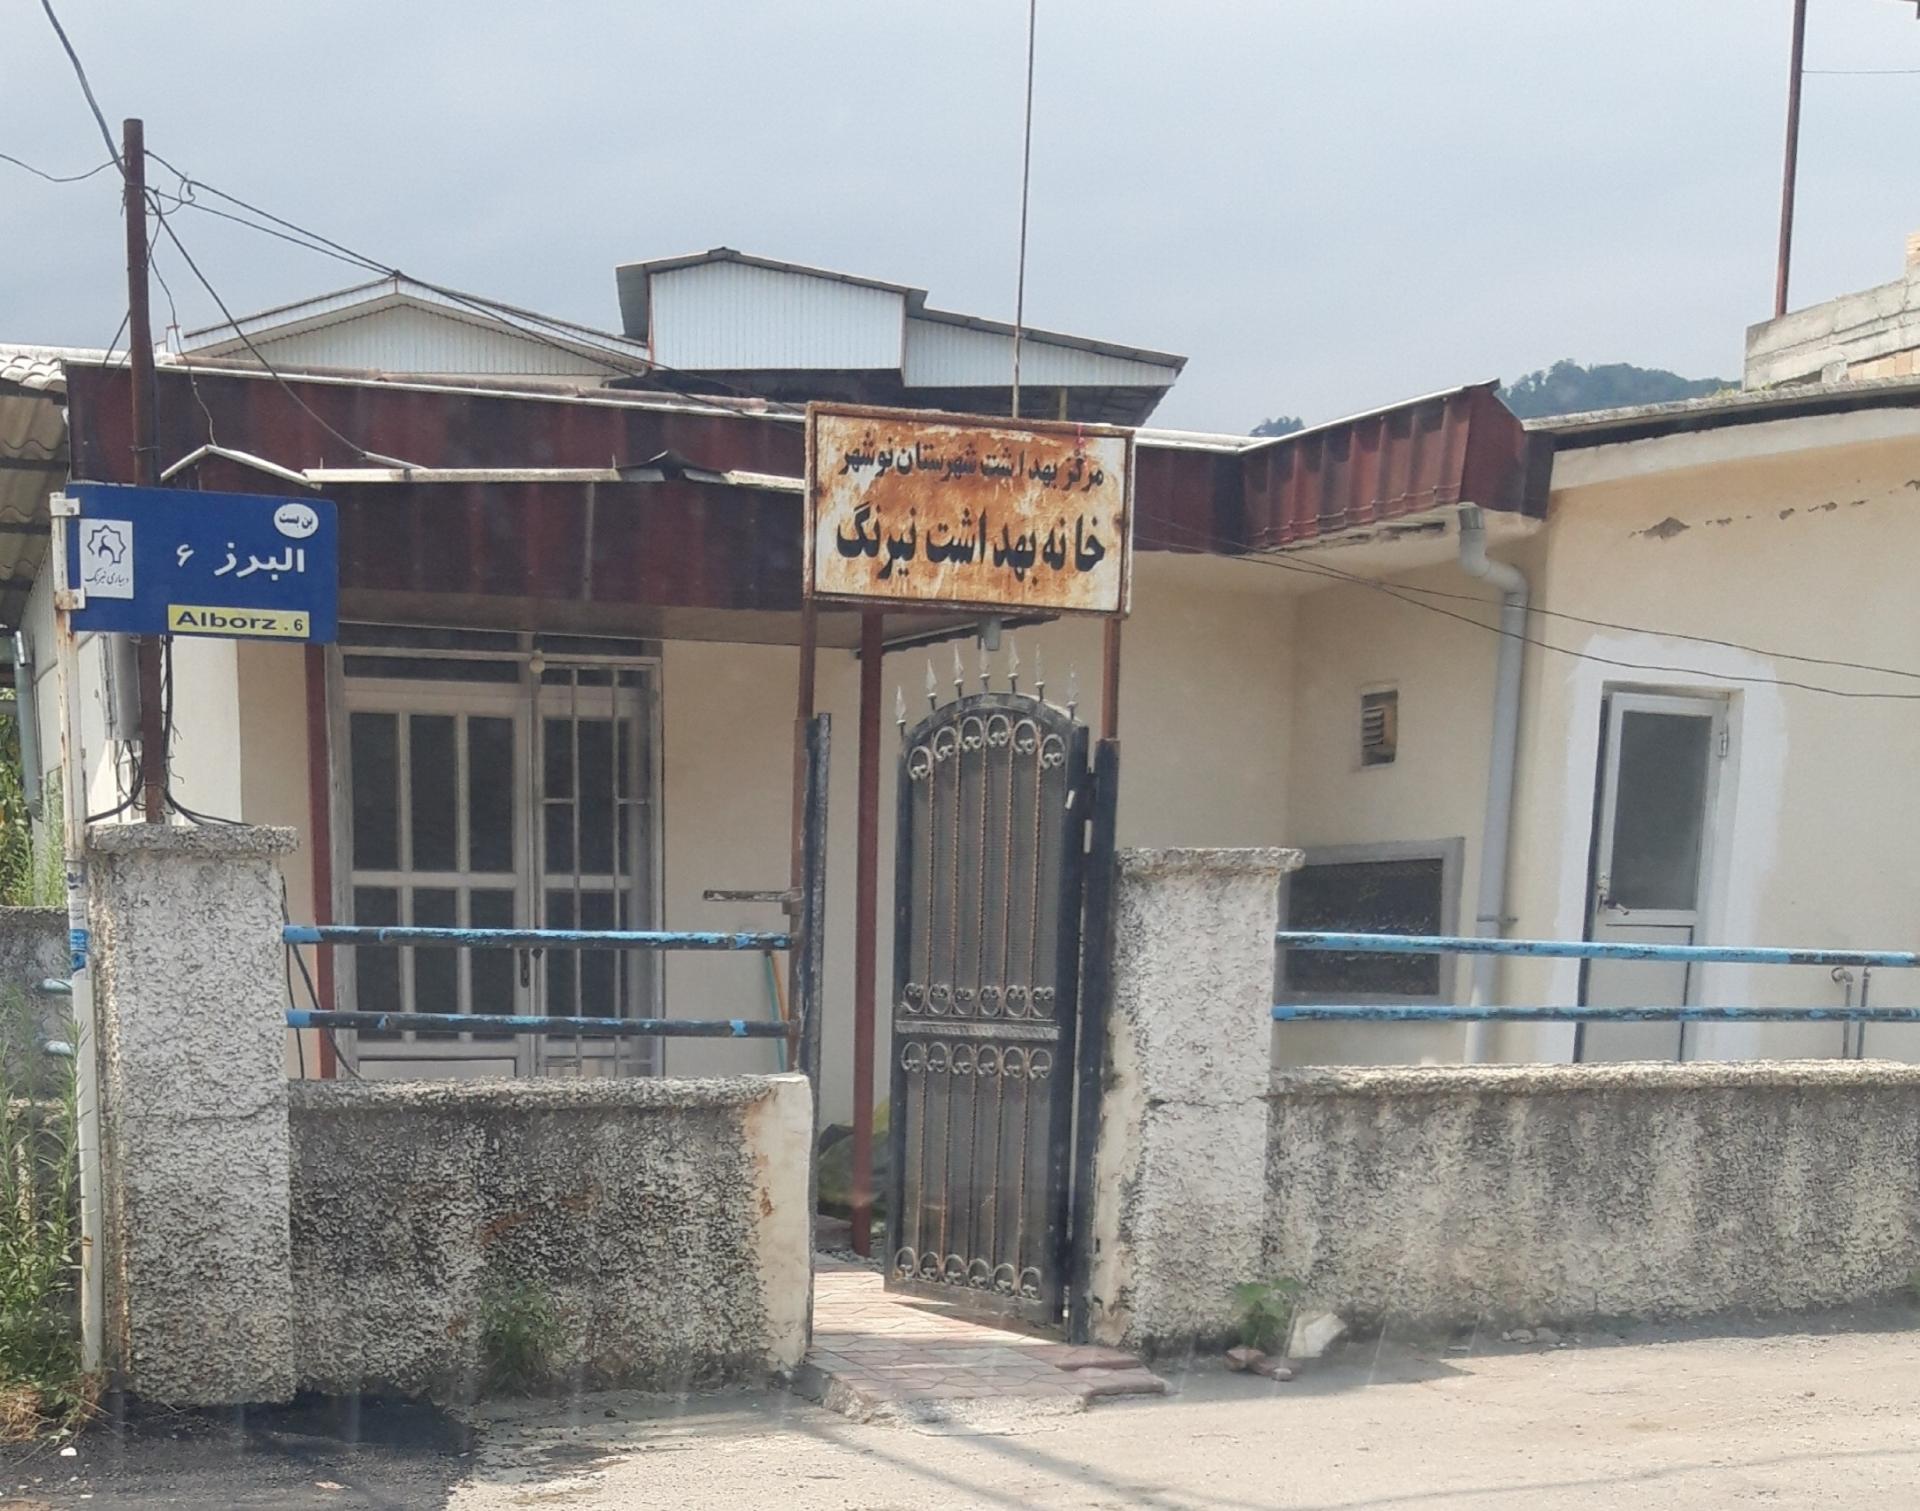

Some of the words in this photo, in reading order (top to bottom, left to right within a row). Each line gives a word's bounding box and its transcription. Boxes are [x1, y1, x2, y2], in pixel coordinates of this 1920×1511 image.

[838, 431, 894, 477] نوشهر
[896, 441, 977, 482] شهرستان
[980, 447, 1058, 488] بهداشت
[1061, 448, 1105, 492] مرکز
[279, 513, 300, 528] بست
[301, 516, 313, 530] بن
[836, 501, 917, 580] نیرنگ
[176, 543, 195, 567] ۶
[213, 541, 305, 581] البرز
[925, 507, 1039, 586] بهداشت
[1042, 513, 1106, 572] خانه
[176, 611, 277, 630] Alborz
